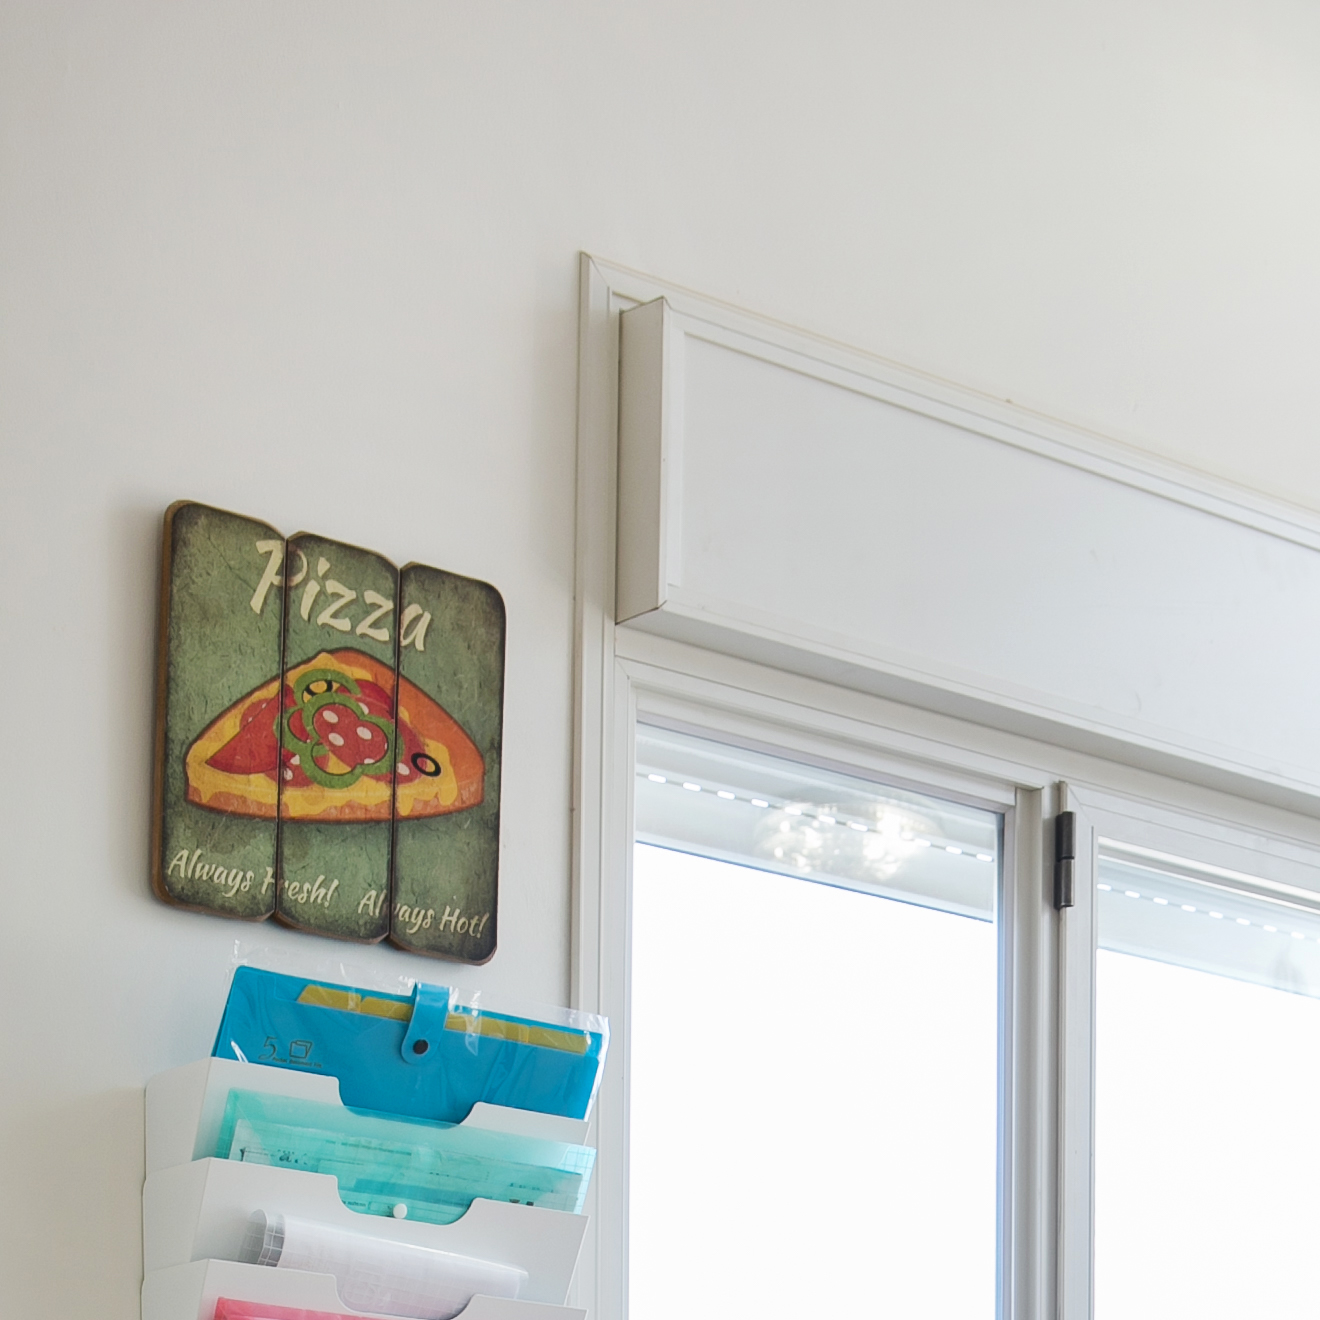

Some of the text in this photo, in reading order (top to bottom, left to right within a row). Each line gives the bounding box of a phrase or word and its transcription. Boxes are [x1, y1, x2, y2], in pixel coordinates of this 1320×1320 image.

[250, 539, 432, 653] Pizza
[167, 849, 253, 898] Always
[439, 902, 489, 939] Hot!
[258, 1035, 278, 1060] 5
